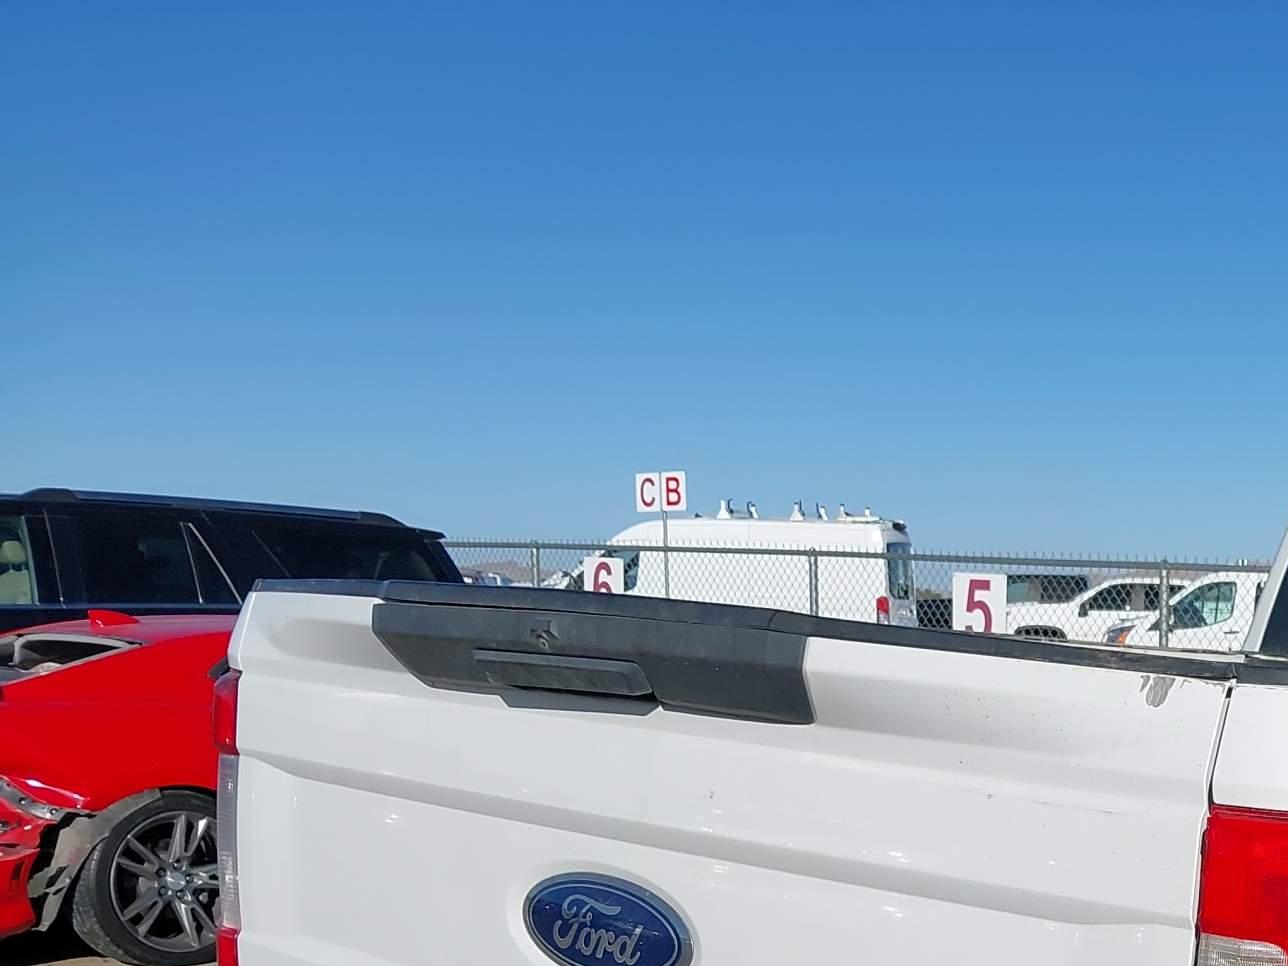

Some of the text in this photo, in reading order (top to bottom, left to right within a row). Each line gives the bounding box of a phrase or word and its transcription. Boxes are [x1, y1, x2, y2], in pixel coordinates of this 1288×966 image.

[640, 476, 682, 508] C B
[592, 561, 613, 594] 6
[965, 579, 993, 635] 5
[552, 893, 642, 966] Ford
